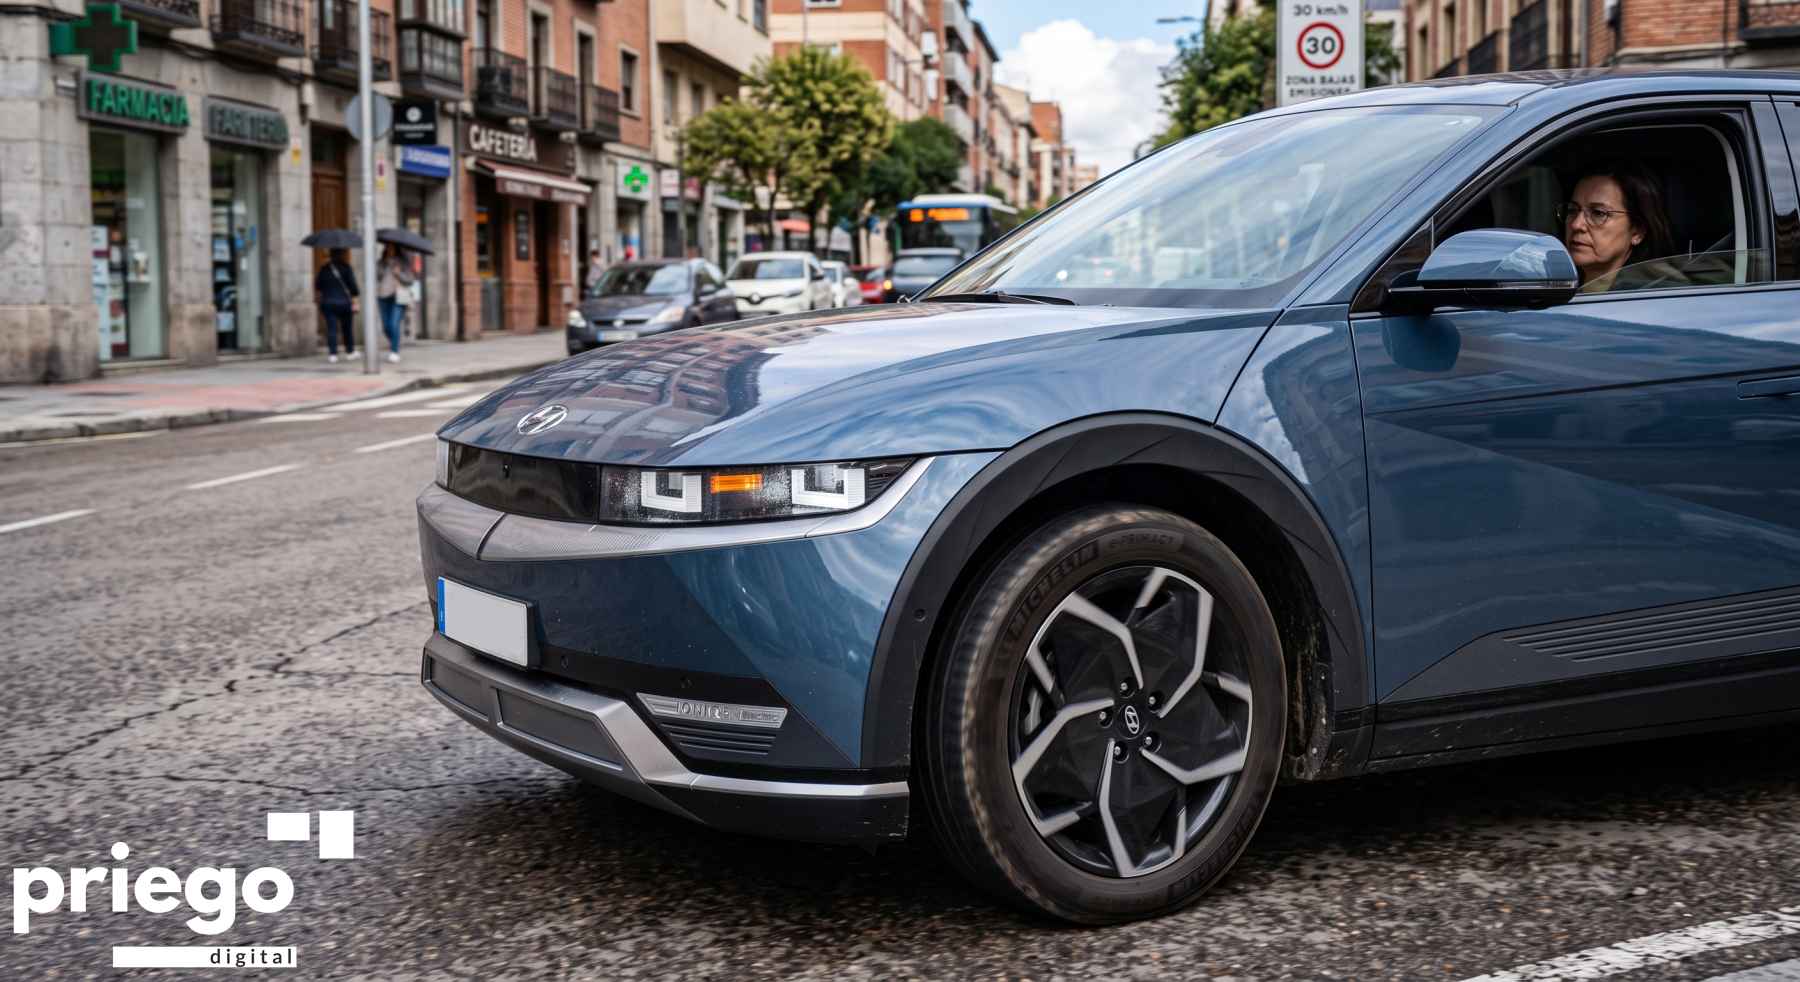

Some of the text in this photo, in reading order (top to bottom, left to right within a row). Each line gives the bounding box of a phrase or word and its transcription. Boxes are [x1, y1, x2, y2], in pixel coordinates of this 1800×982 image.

[1294, 4, 1348, 16] 30 km/h
[1305, 36, 1335, 54] 30
[1286, 75, 1315, 85] ZONA
[85, 79, 190, 126] FARMACIA
